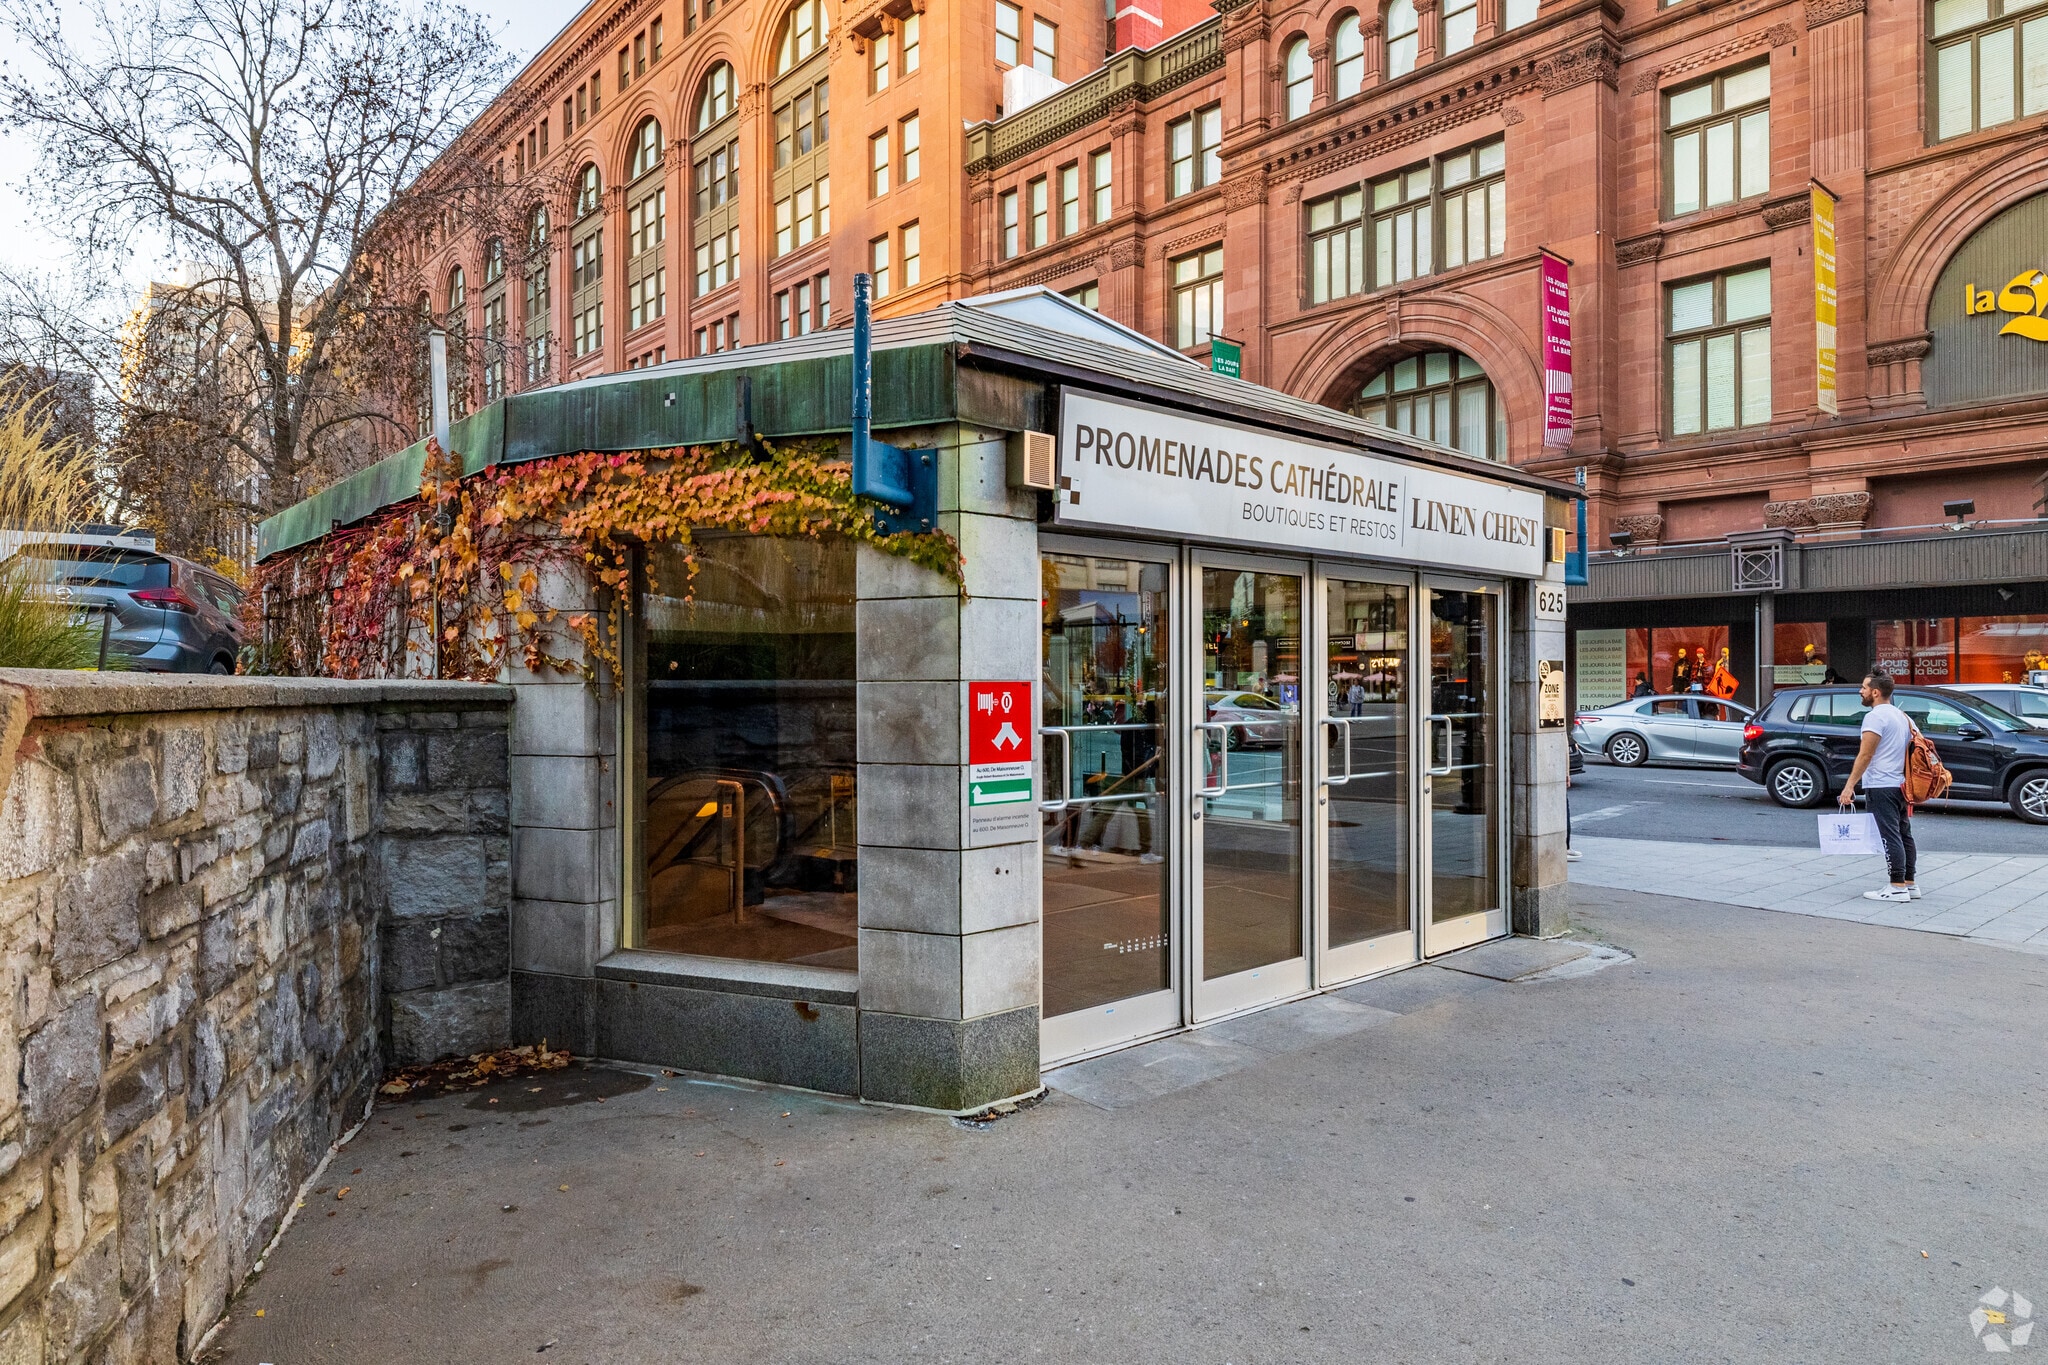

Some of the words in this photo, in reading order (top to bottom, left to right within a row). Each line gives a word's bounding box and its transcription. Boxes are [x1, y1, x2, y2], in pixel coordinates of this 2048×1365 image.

[1966, 283, 1996, 315] la
[1547, 305, 1556, 314] LES
[1552, 315, 1558, 323] LA
[1548, 336, 1558, 344] LES
[1554, 396, 1570, 405] NOTRE
[1075, 423, 1263, 490] PROMENADES
[1270, 462, 1399, 512] CATHÉDRALE
[1242, 502, 1325, 530] BOUTIQUES
[1330, 515, 1347, 532] ET
[1350, 518, 1397, 540] RESTOS
[1410, 497, 1477, 537] LINEN
[1482, 510, 1539, 548] CHEST
[1539, 591, 1564, 614] 625
[1880, 658, 1908, 667] Jours
[1916, 658, 1948, 667] Jours
[1889, 667, 1910, 676] Baie
[1914, 668, 1924, 676] la
[1926, 667, 1948, 676] Baie
[1544, 684, 1560, 693] ZONE
